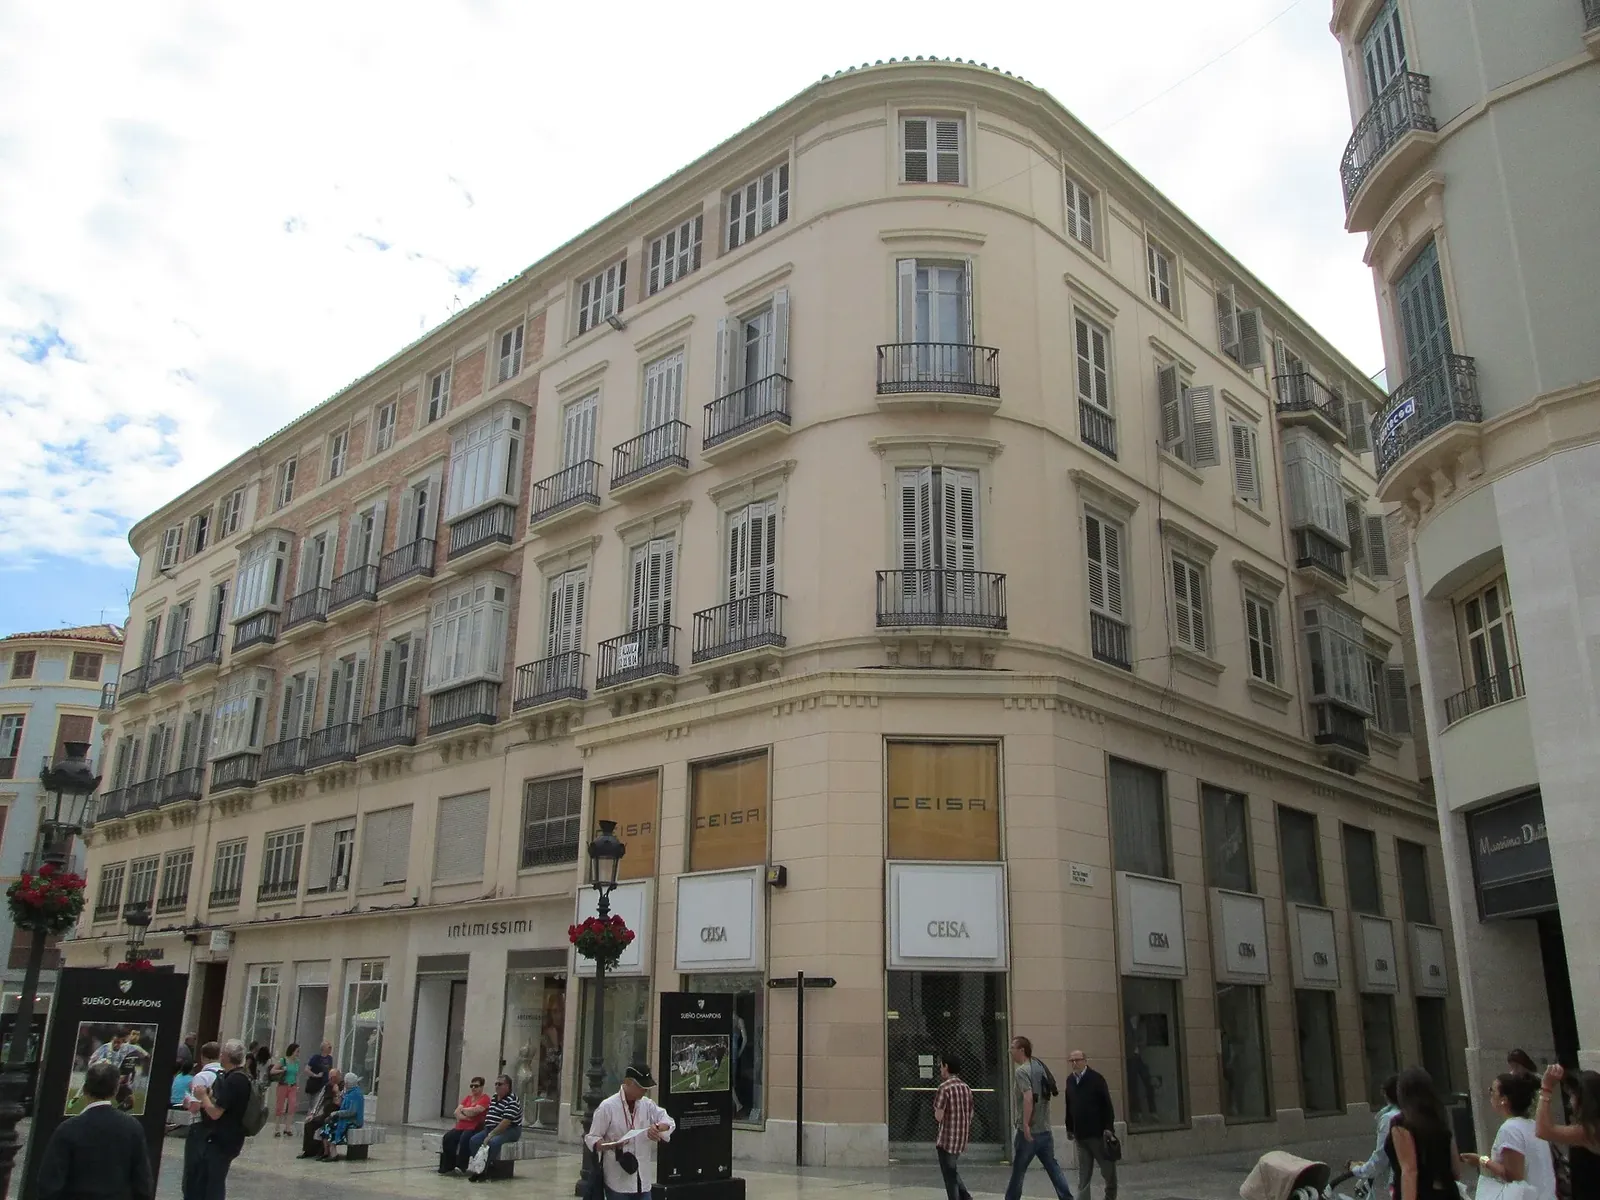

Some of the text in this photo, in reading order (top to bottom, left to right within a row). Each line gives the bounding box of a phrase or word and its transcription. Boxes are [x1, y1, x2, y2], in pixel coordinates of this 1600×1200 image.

[893, 797, 986, 811] CEISA
[696, 808, 760, 830] CEISA
[595, 822, 651, 838] CISA
[448, 920, 532, 937] intimissimi
[700, 926, 728, 943] CEISA
[927, 920, 970, 938] CEISA
[1148, 932, 1170, 949] CEISA
[82, 997, 162, 1008] SUEÑO CHAMPIONS
